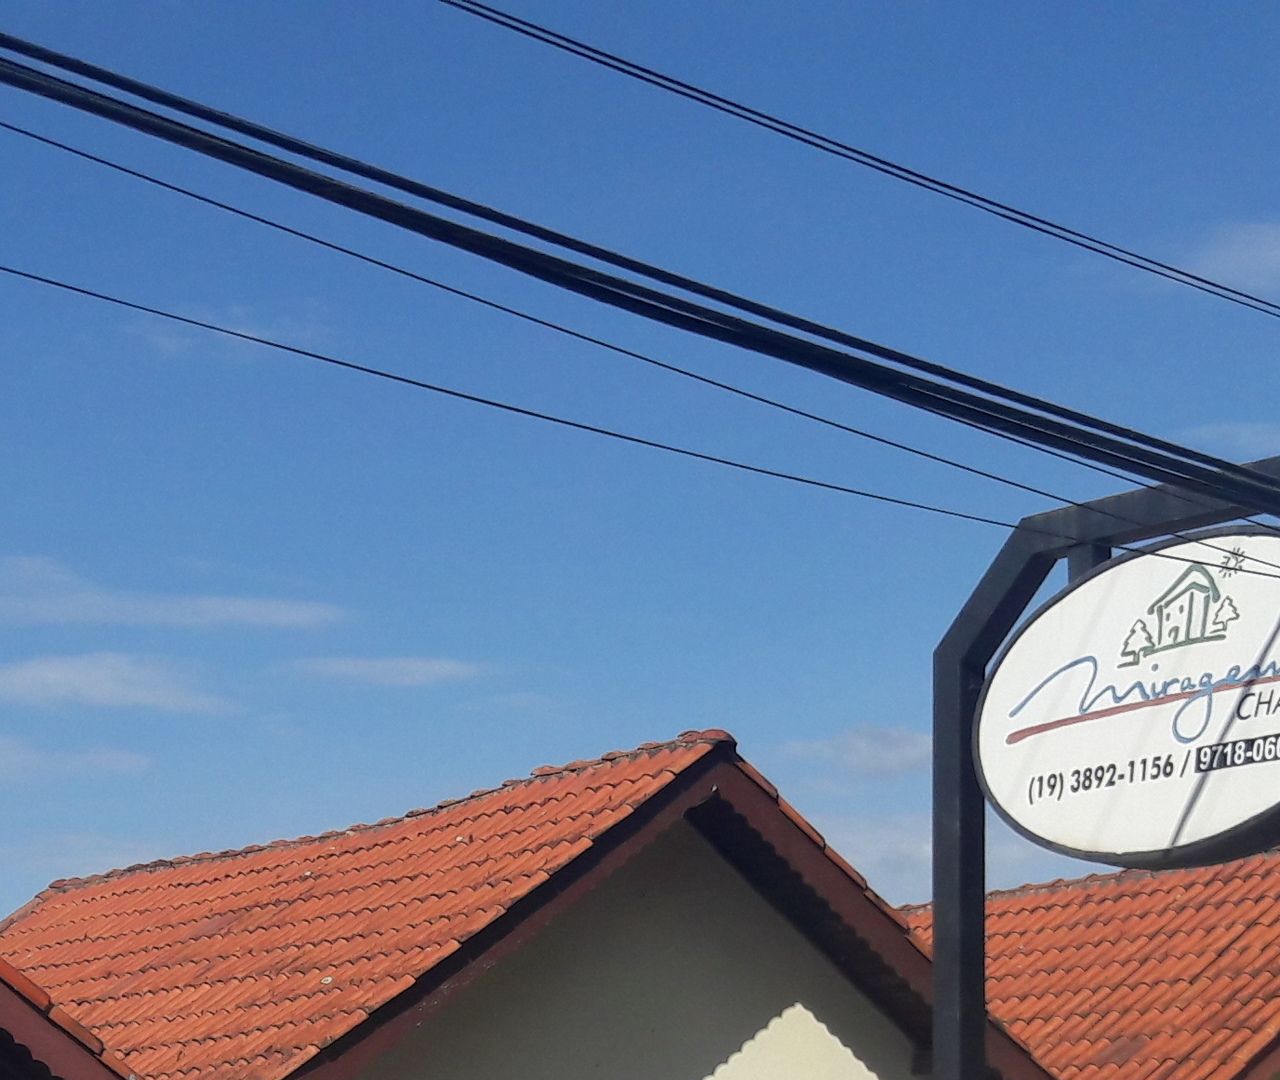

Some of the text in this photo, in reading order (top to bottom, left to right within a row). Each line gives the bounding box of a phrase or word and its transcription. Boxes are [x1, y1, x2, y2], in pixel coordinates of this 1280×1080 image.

[1028, 773, 1065, 805] (19)
[1070, 755, 1175, 794] 3892-1156
[1179, 750, 1191, 778] /
